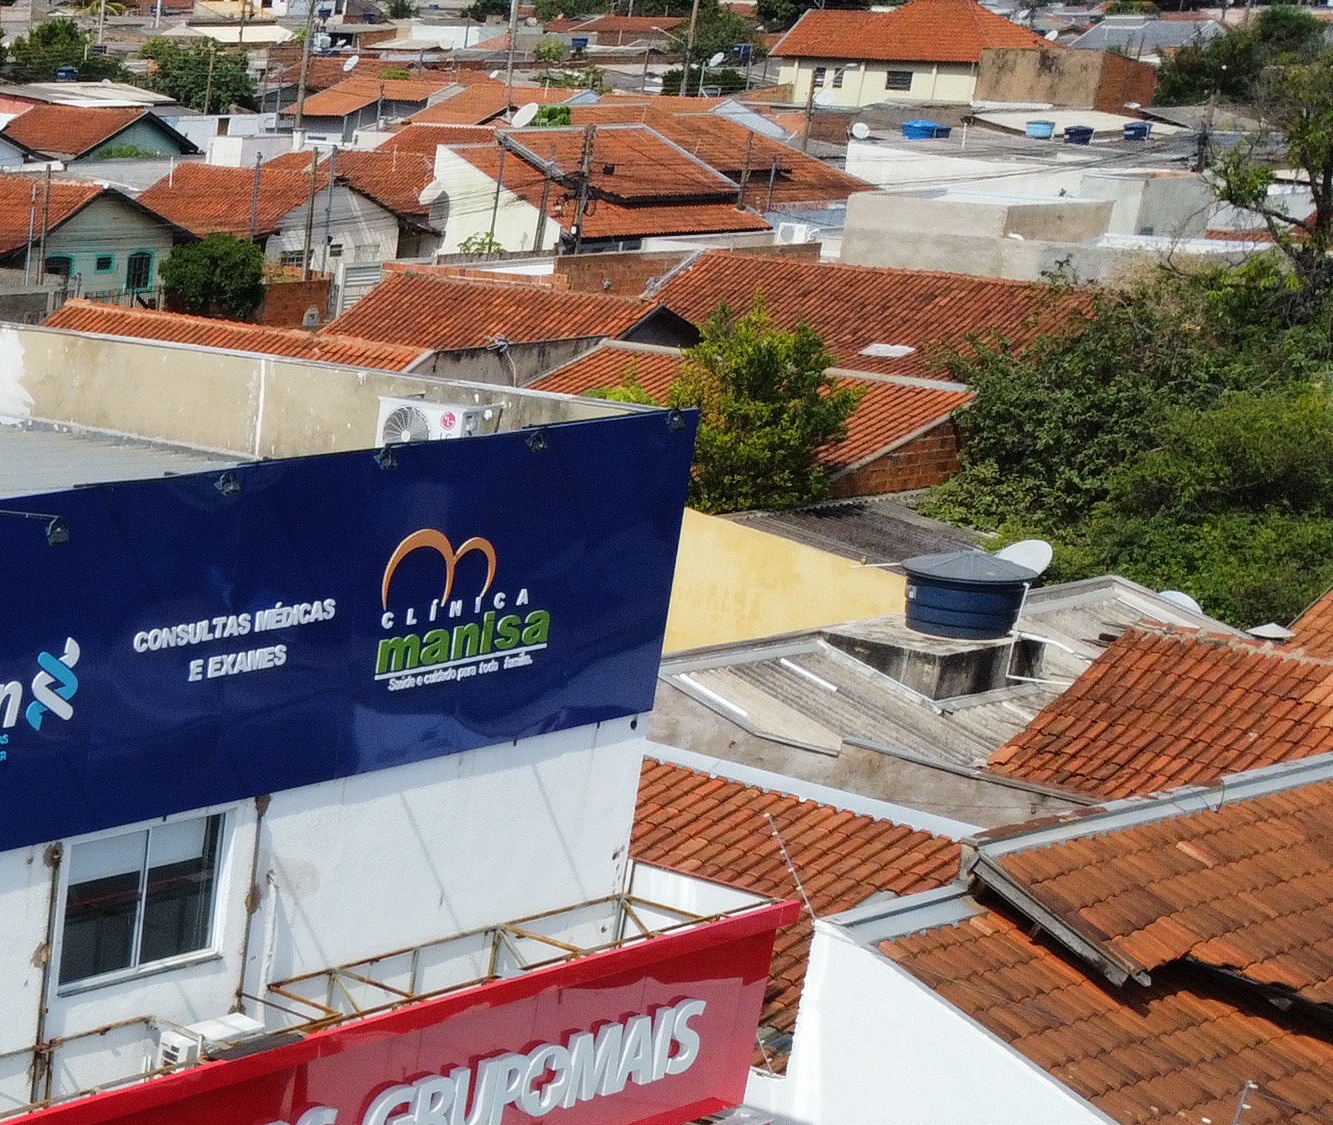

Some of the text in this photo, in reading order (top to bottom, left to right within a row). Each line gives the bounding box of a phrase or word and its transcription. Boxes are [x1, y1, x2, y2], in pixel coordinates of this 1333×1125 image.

[133, 597, 336, 653] CONSULTAS MÉDICAS
[381, 588, 529, 630] CLÍNICA
[188, 644, 287, 682] E EXAMES
[374, 609, 551, 674] manisa
